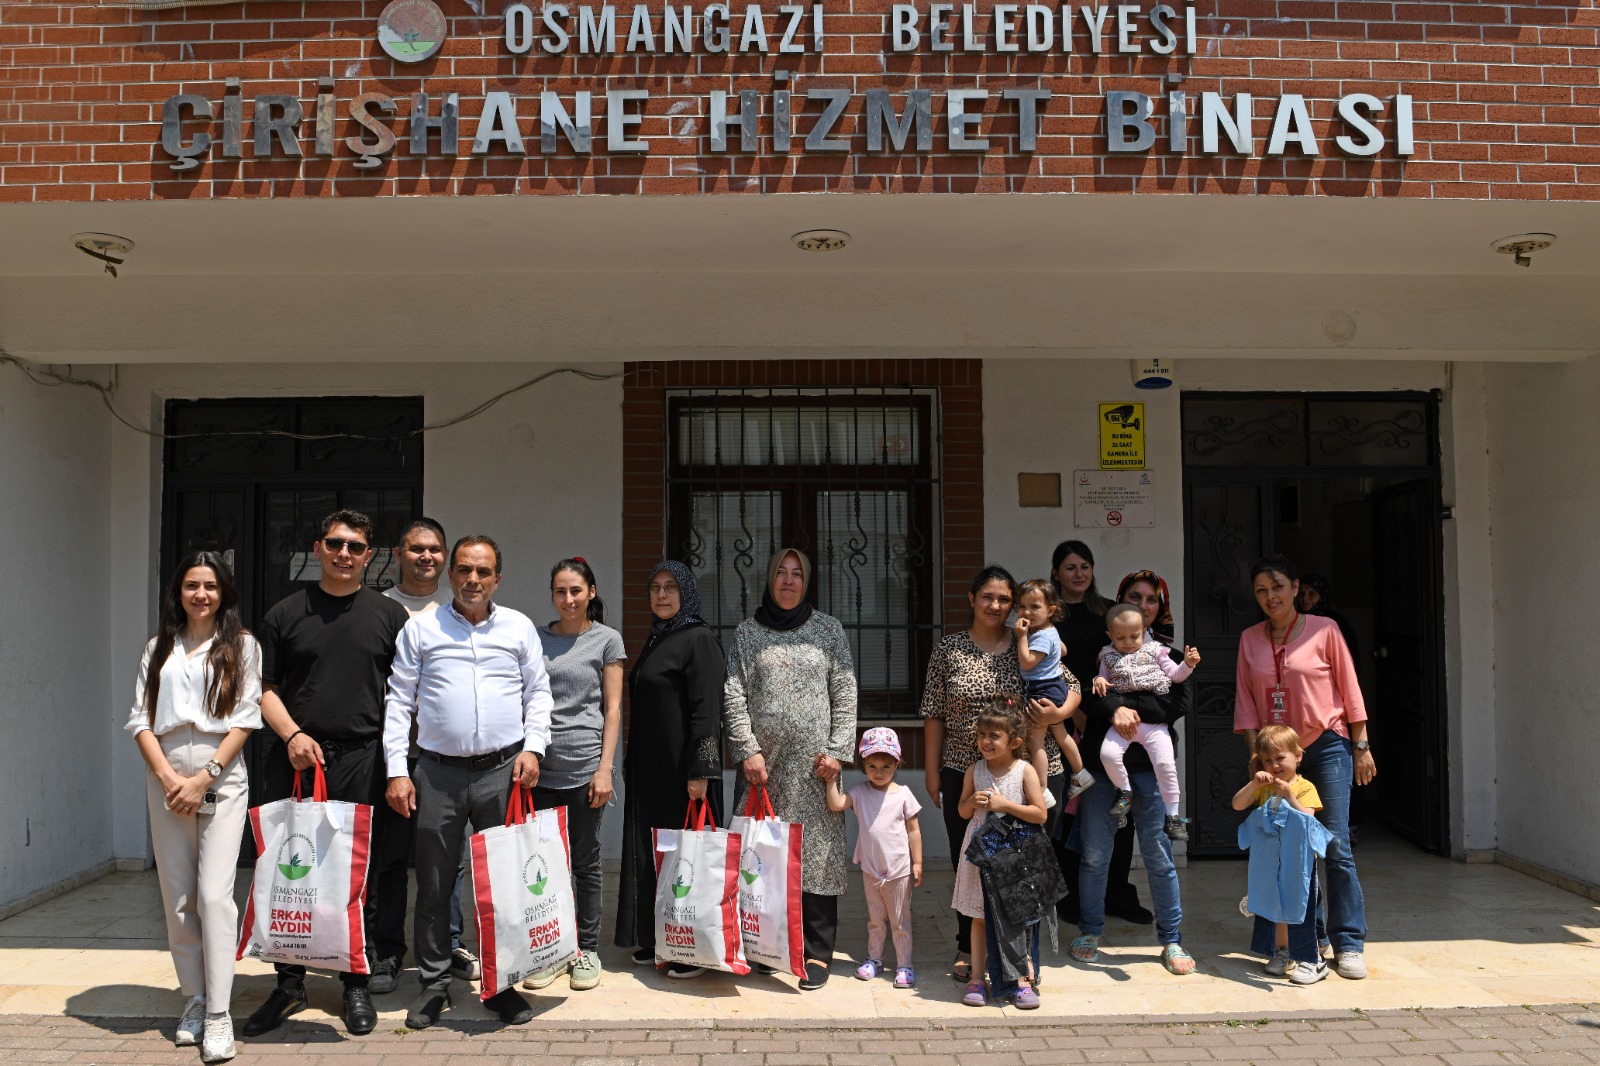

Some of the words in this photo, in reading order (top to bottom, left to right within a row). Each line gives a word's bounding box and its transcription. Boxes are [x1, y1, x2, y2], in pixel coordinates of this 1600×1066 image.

[160, 76, 649, 171] ÇİRİŞHANE
[710, 70, 1051, 153] HİZMET
[1106, 73, 1415, 157] BİNASI
[270, 908, 312, 922] ERKAN
[269, 920, 312, 934] AYDIN
[529, 917, 559, 938] ERKAN
[664, 922, 694, 935] ERKAN
[529, 927, 561, 949] AYDIN
[665, 933, 696, 946] AYDIN
